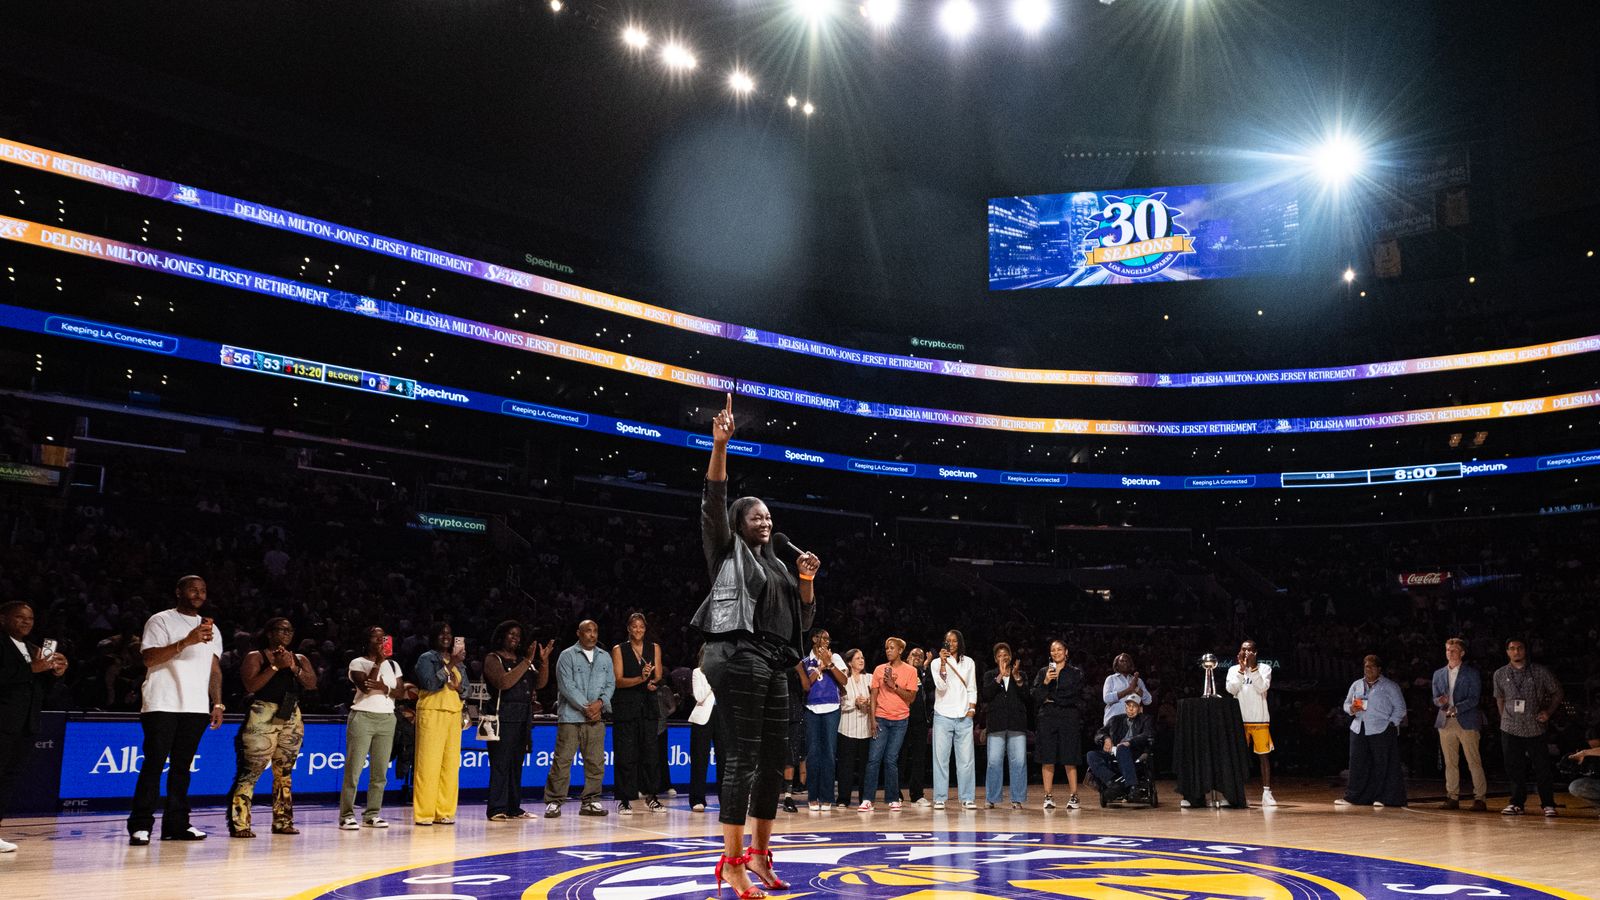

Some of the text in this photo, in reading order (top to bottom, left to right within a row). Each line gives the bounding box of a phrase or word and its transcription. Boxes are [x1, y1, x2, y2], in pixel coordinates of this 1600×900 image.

[52, 156, 140, 189] RETIREMENT
[179, 186, 196, 199] 30
[1102, 199, 1168, 247] 30
[234, 203, 473, 272] DELISHA MILTON-JONES JERSEY RETIREMENT
[1103, 238, 1173, 261] SEASONS
[41, 229, 330, 303] DELISHA MILTON-JONES JERSEY RETIREMENT
[524, 253, 572, 274] Spectrum
[1108, 253, 1173, 275] LOS ANGELES SPARKS
[360, 298, 375, 309] 30
[543, 281, 722, 334] DELISHA MILTON-JONES JERSEY RETIREMENT
[61, 322, 163, 347] Keeping LA Connected
[405, 310, 615, 366] DELISHA MILTON-JONES JERSEY RETIREMENT
[919, 339, 964, 350] crypto.com
[233, 352, 251, 365] 56
[778, 338, 933, 371] DELISHA MILTON-JONES JERSEY RETIREMENT
[1416, 358, 1451, 371] DELISHA
[1453, 351, 1517, 366] MILTON-JONES
[1518, 347, 1549, 360] JERSEY
[263, 358, 280, 371] 53
[293, 363, 322, 378] 13:20
[328, 370, 359, 382] BLOCKS
[368, 378, 376, 387] 0
[1068, 373, 1093, 383] JERSEY
[1094, 375, 1139, 385] RETIREMENT
[1192, 368, 1357, 385] DELISHA MILTON-JONES JERSEY RETIREMENT
[395, 383, 403, 392] 4
[415, 384, 467, 403] Spectrum
[671, 369, 840, 408] DELISHA MILTON-JONES JERSEY RETIREMENT
[1553, 395, 1594, 409] DELISHA
[511, 405, 579, 423] Keeping LA Connected
[889, 407, 1046, 431] DELISHA MILTON-JONES JERSEY RETIREMENT
[1310, 407, 1492, 430] DELISHA MILTON-JONES JERSEY RETIREMENT
[616, 422, 659, 438] Spectrum
[1095, 422, 1257, 434] DELISHA MILTON-JONES JERSEY RETIREMENT
[695, 438, 714, 447] Keepin
[785, 450, 823, 463] Spectrum
[1547, 458, 1571, 466] Keeping
[854, 462, 874, 471] Keeping
[881, 464, 908, 473] Connected
[939, 467, 976, 480] Spectrum
[1394, 467, 1437, 480] 8:00
[1462, 463, 1506, 475] Spectrum
[1008, 475, 1026, 483] Keeping
[1121, 477, 1159, 487] Spectrum
[1316, 472, 1335, 480] LA28
[428, 516, 486, 531] crypto.com
[34, 739, 55, 749] ert
[88, 746, 201, 774] Albt
